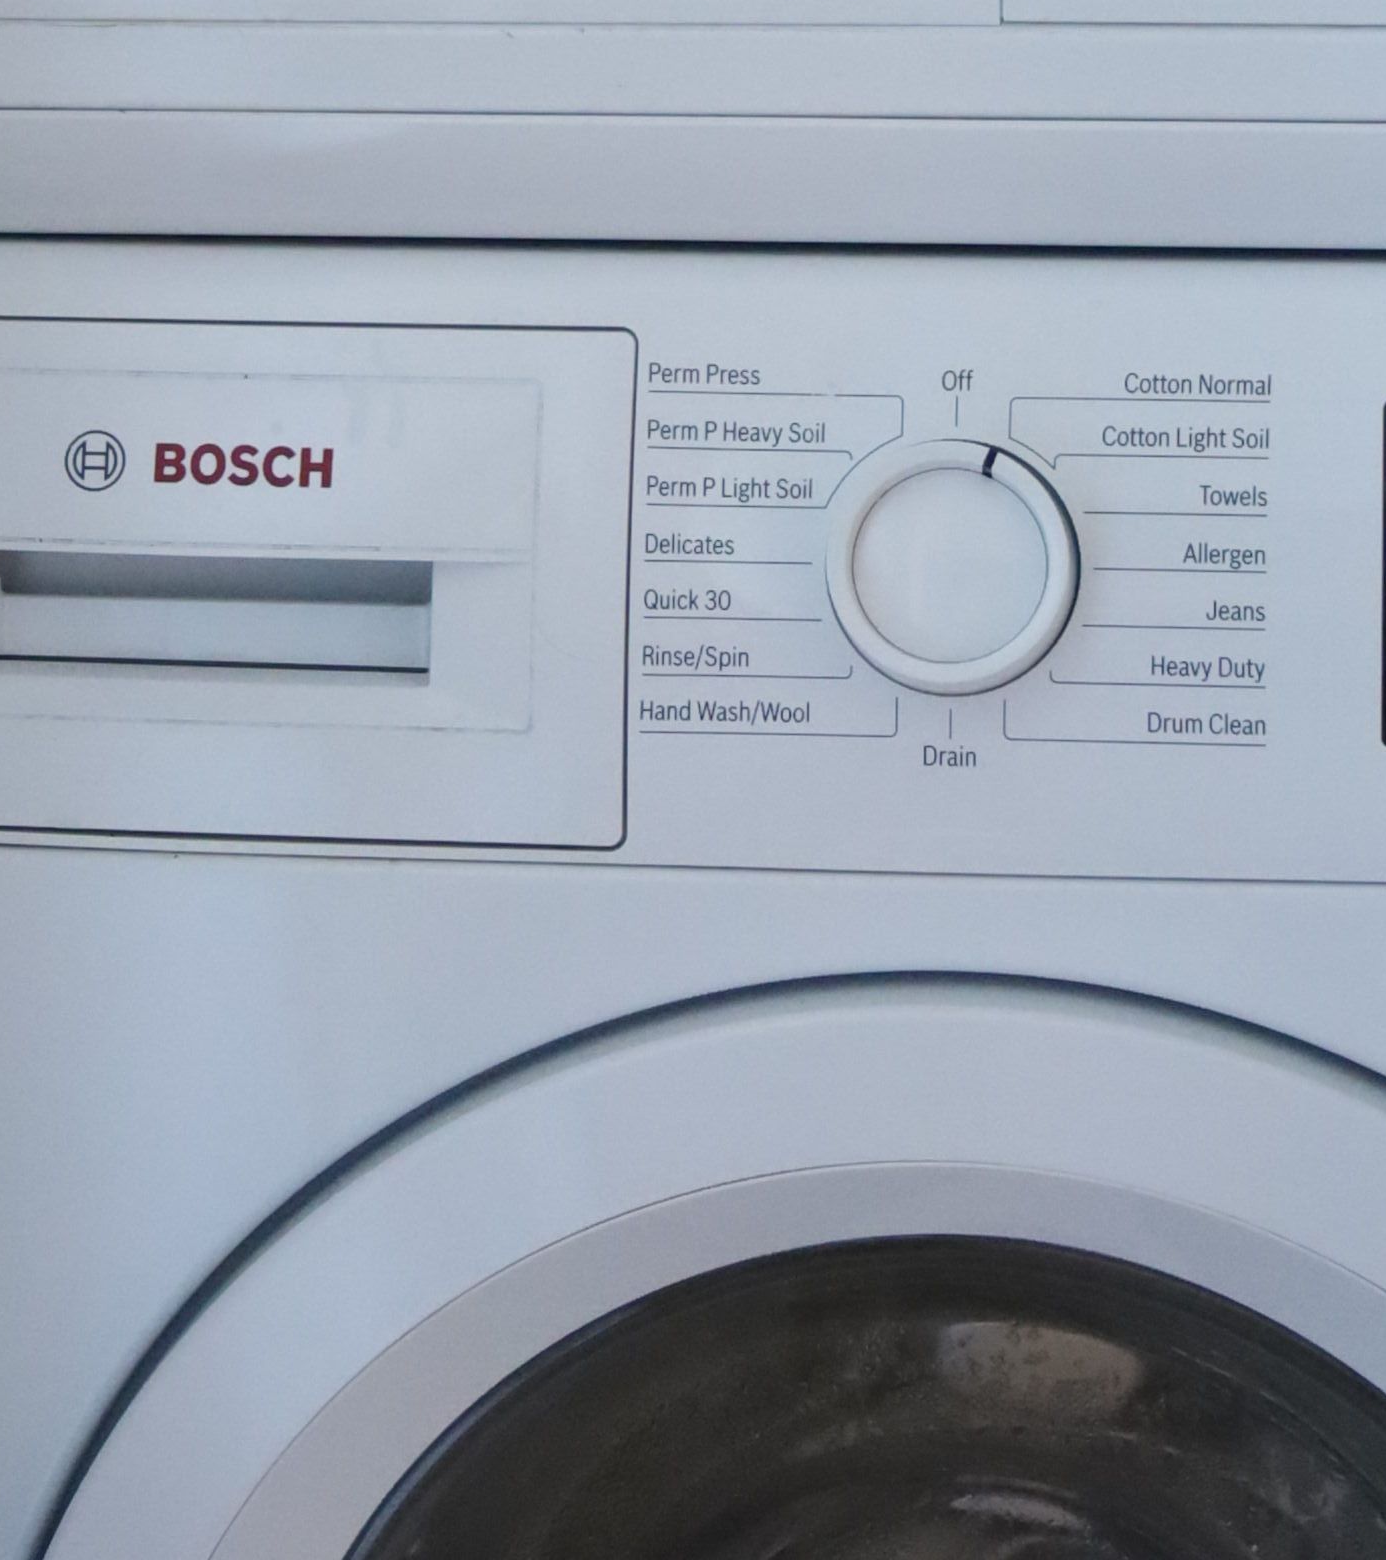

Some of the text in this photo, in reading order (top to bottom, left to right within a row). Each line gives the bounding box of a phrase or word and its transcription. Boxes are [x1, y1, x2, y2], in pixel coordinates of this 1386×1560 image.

[648, 362, 761, 386] Perm Press
[941, 369, 974, 392] Off
[1124, 372, 1272, 396] Cotton Normal
[647, 418, 826, 448] Perm P Heavy Soil
[1102, 425, 1270, 454] Cotton Light Soil
[152, 442, 335, 489] BOSCH
[646, 475, 813, 504] Perm P Light Soil
[1199, 484, 1268, 507] Towels
[645, 532, 735, 556] Delicates
[1182, 542, 1266, 568] Allergen
[643, 588, 732, 611] Quick 30
[1205, 600, 1266, 622] Jeans
[642, 644, 750, 672] Rinse/Spin
[1151, 655, 1266, 683] Heavy Duty
[639, 699, 811, 726] Hand Wash/Wool
[1147, 711, 1266, 736] Drum Clean
[923, 744, 977, 767] Drain
